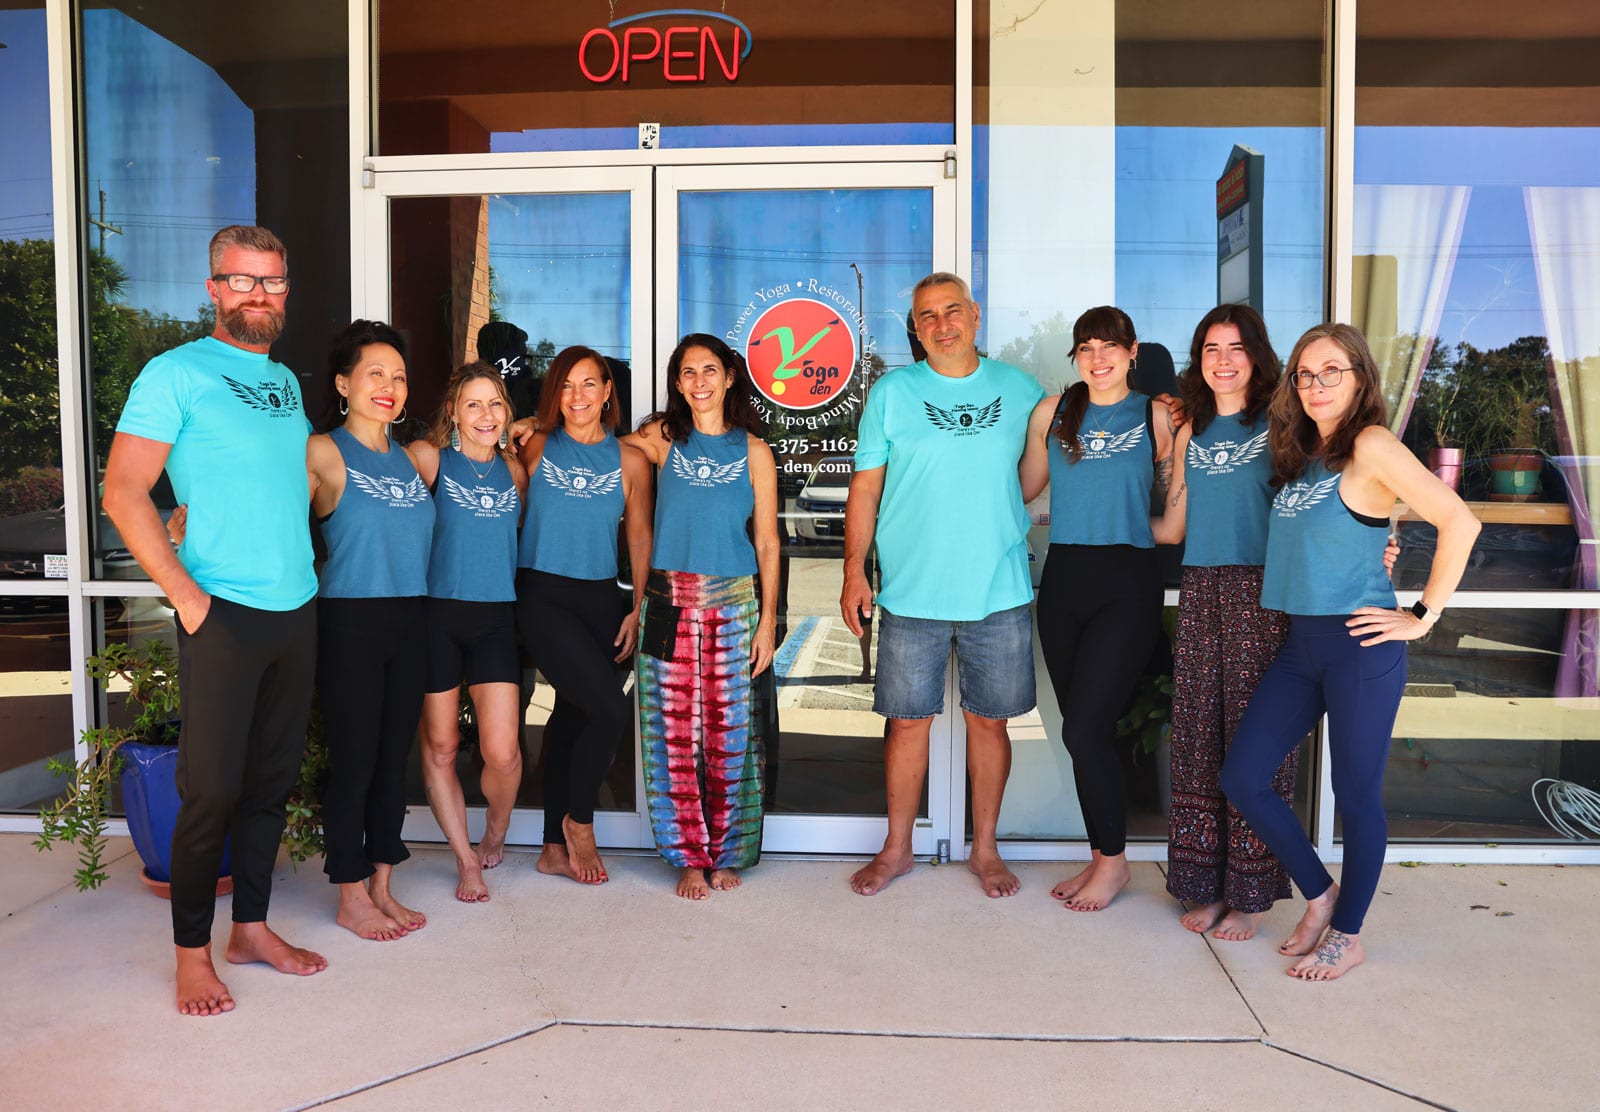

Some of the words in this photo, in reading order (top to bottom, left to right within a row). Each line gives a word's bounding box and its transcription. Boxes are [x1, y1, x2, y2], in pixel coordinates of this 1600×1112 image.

[578, 26, 741, 83] OPEN
[726, 301, 757, 342] Power
[754, 283, 792, 302] Yoga
[807, 278, 869, 336] Restorative
[861, 340, 878, 375] Yoga
[809, 385, 831, 395] den
[777, 392, 862, 430] Mind-Body
[761, 437, 858, 454] -375-1162
[776, 460, 851, 473] -den.com
